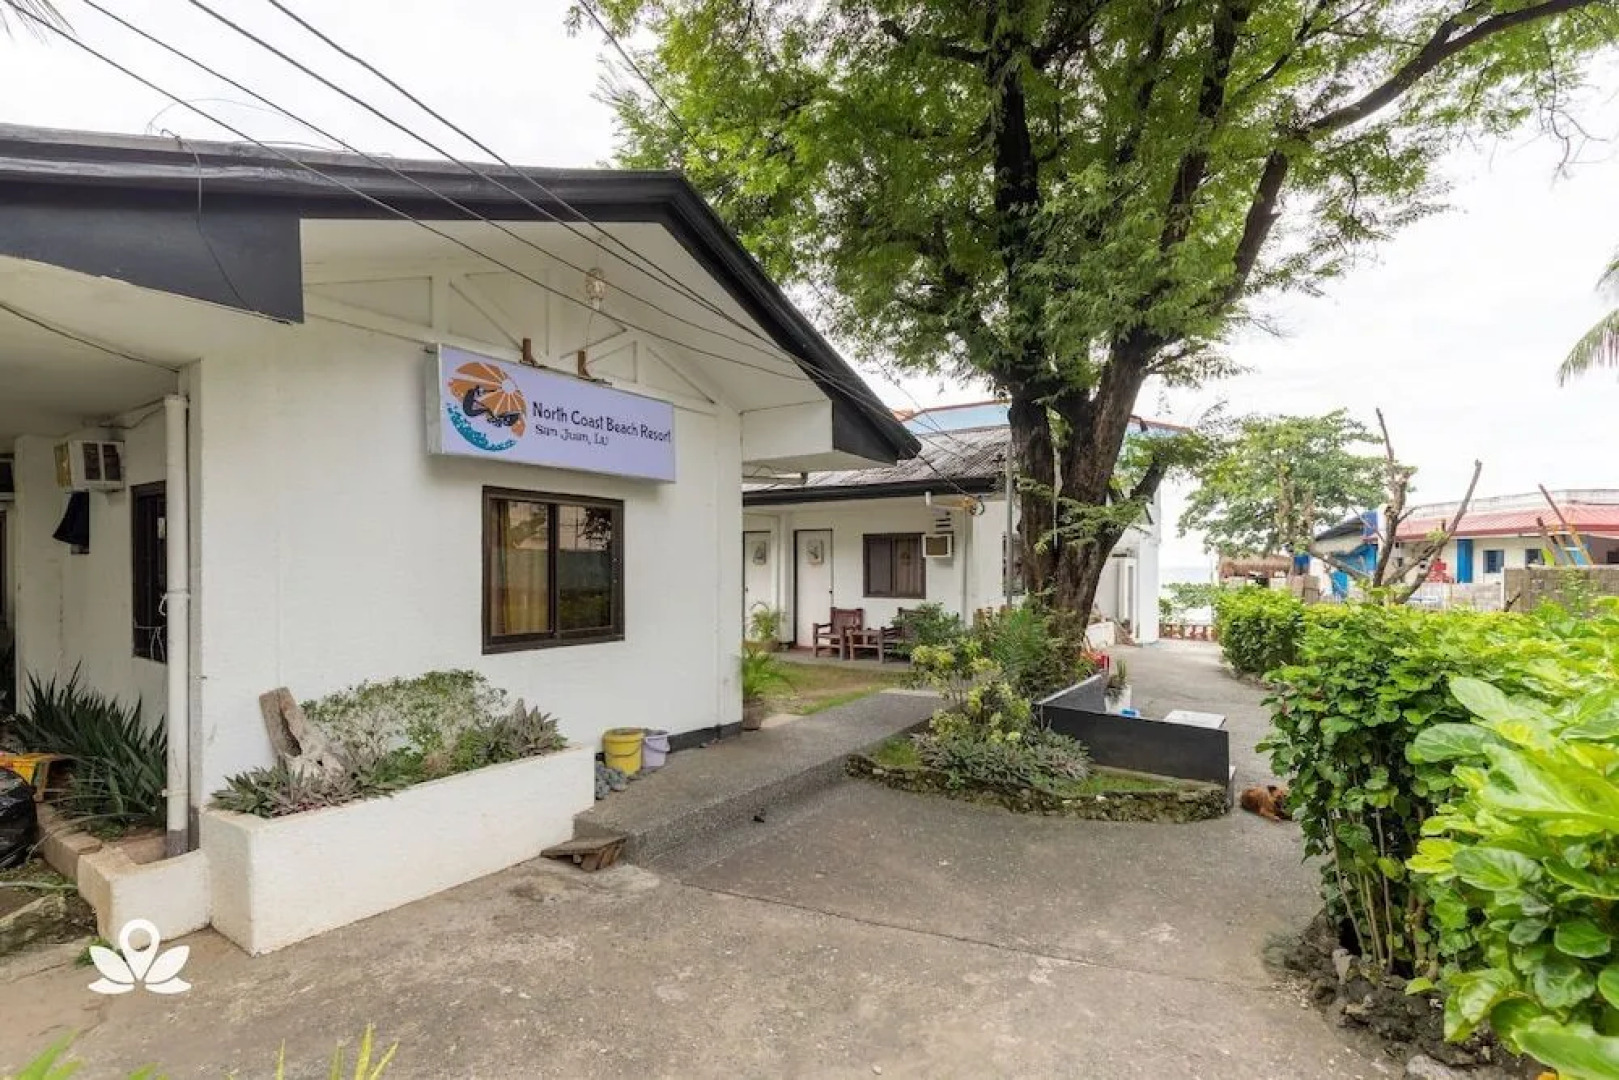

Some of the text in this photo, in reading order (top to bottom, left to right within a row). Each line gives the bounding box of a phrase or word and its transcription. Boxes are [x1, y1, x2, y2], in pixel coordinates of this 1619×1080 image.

[532, 401, 671, 442] North Coast Beach Resort
[535, 424, 558, 437] San
[560, 428, 592, 445] Juan,
